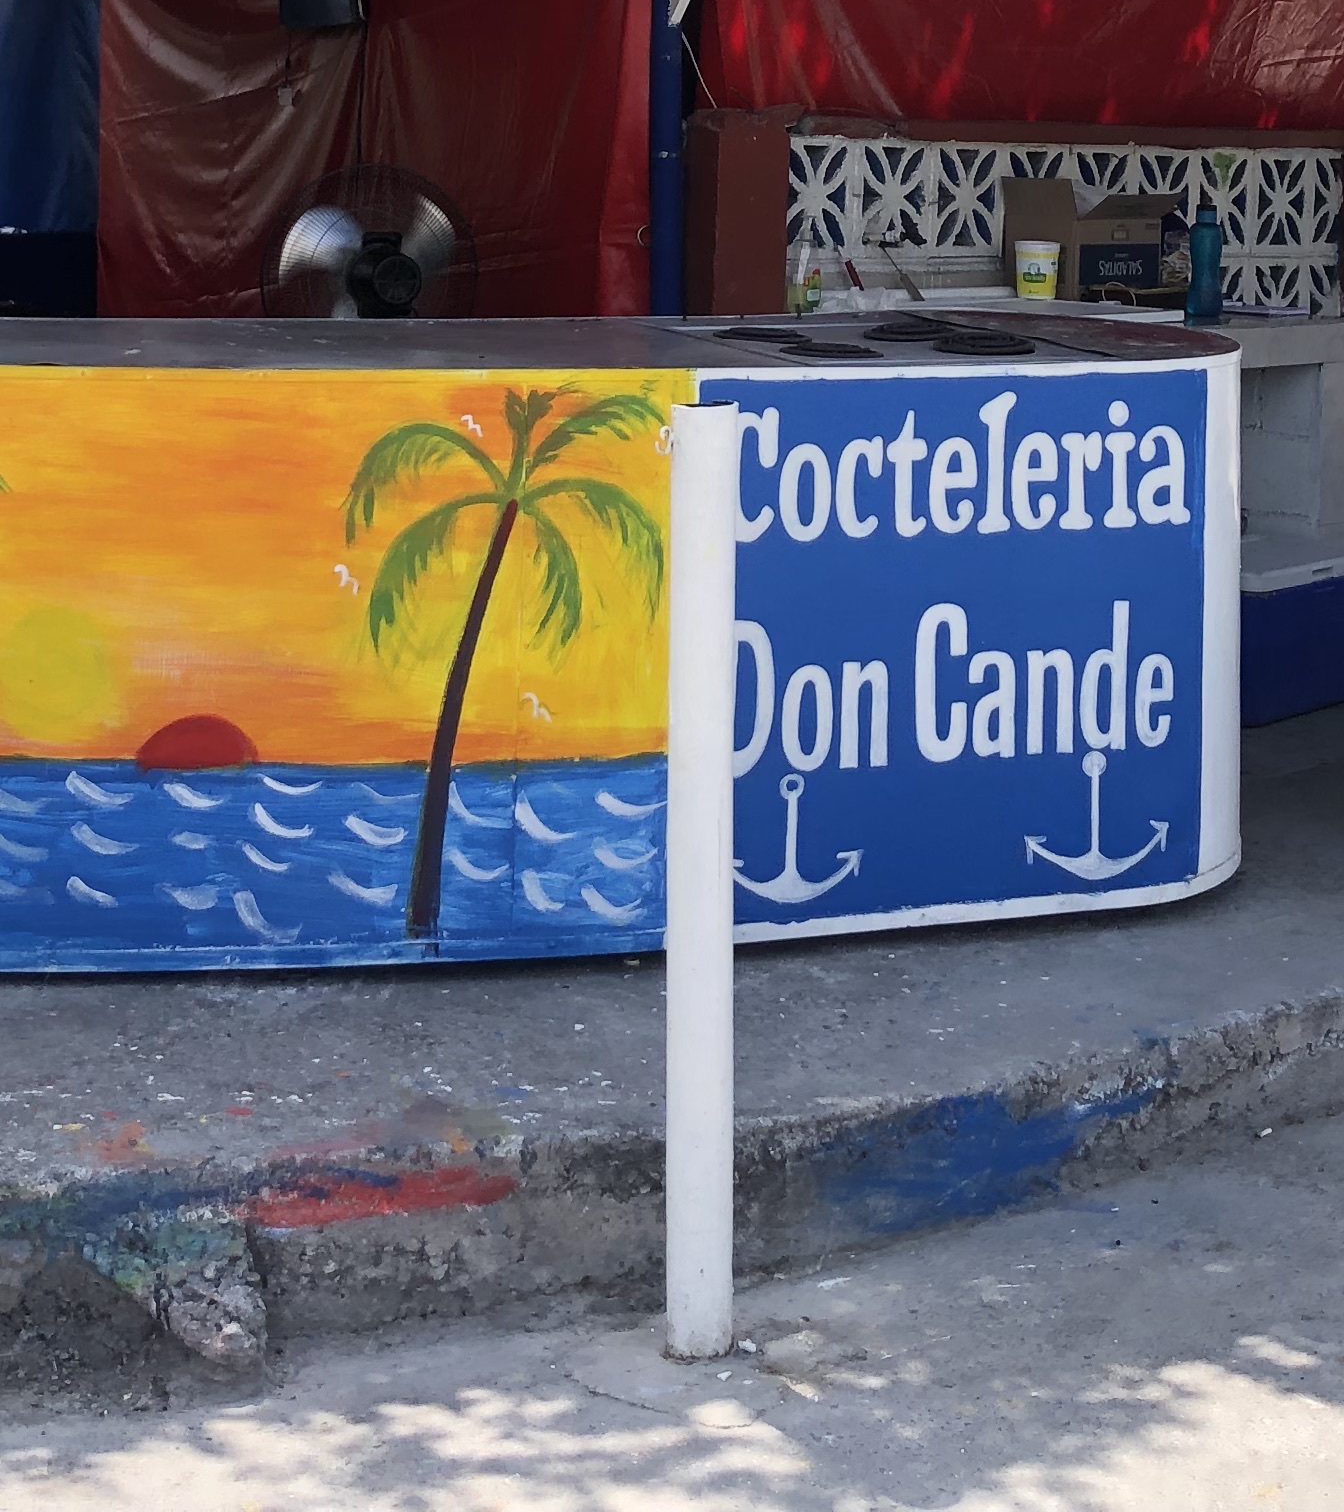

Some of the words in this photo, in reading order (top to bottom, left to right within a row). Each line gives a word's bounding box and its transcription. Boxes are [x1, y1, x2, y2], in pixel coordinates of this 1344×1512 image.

[1098, 259, 1143, 276] SALADITAS
[735, 390, 1191, 543] Cocteleria
[732, 618, 889, 779] Don
[914, 599, 1175, 763] Cande
